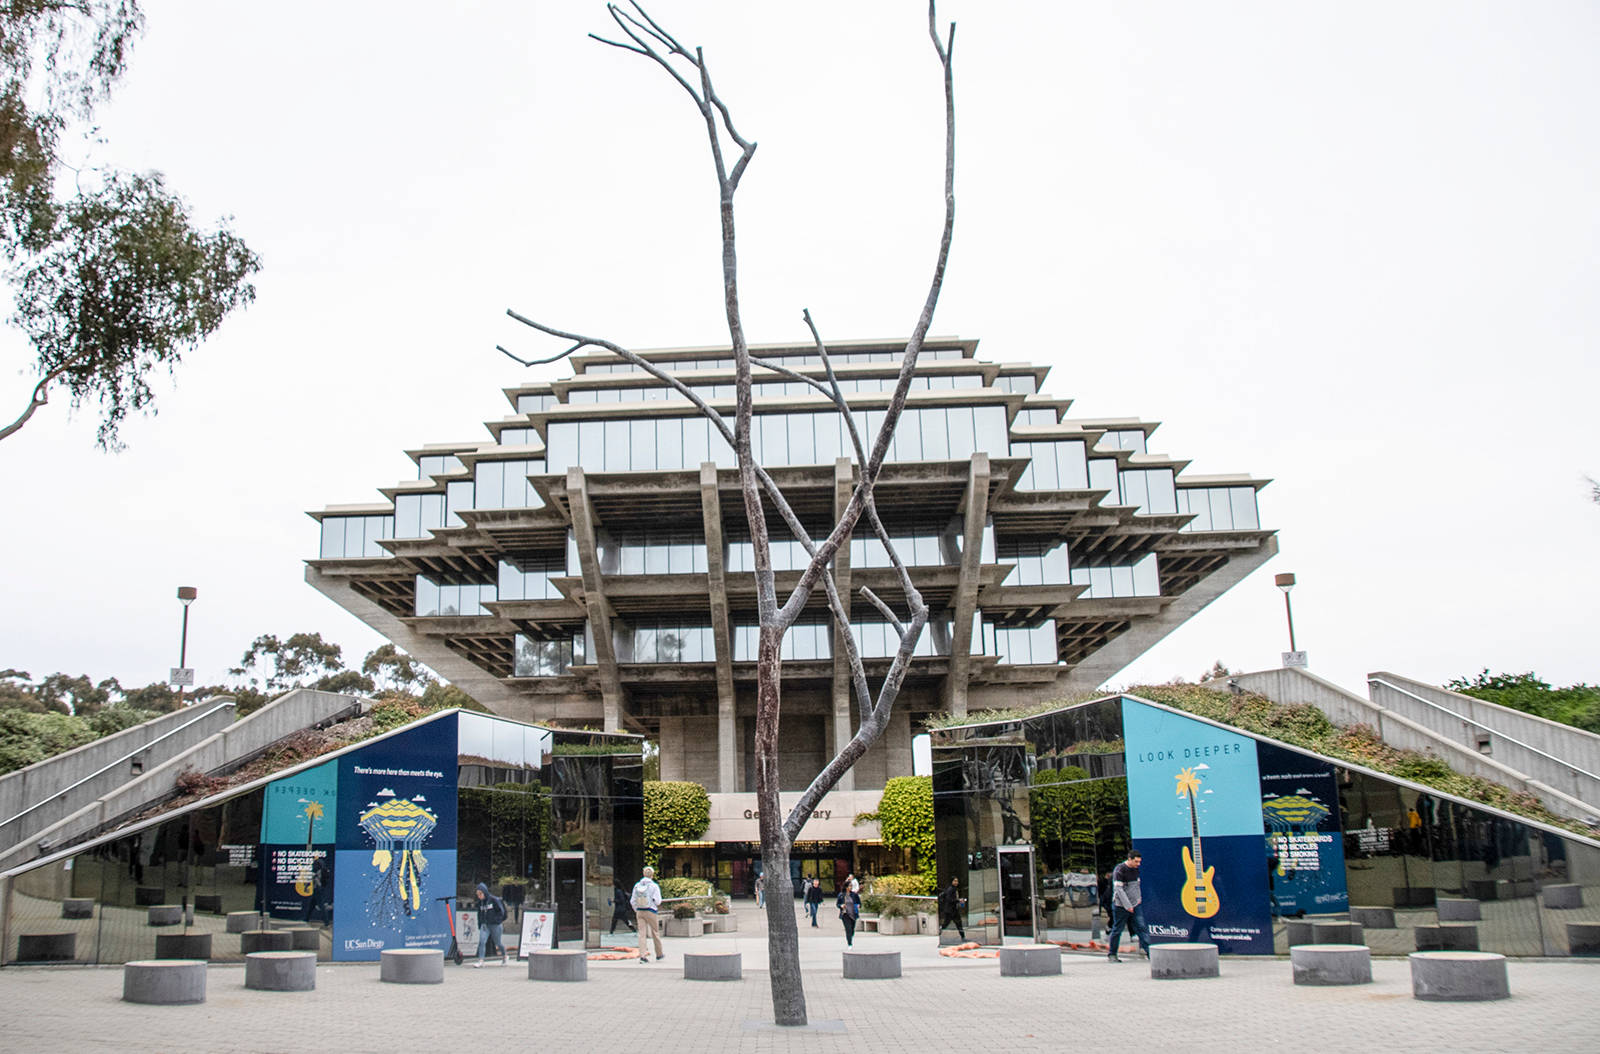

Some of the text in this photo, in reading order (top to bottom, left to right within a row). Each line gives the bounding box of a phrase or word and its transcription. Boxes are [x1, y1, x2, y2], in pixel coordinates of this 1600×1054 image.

[1139, 743, 1241, 763] LOOK DEEPER
[1278, 835, 1333, 844] NO SKATEBOARDS
[1278, 843, 1288, 851] NO
[288, 850, 327, 858] SKATEBOARDS
[1279, 850, 1319, 858] NO SMOKING
[277, 857, 314, 865] NO BICYCLES
[1170, 925, 1189, 938] Diego
[367, 938, 385, 949] Diego
